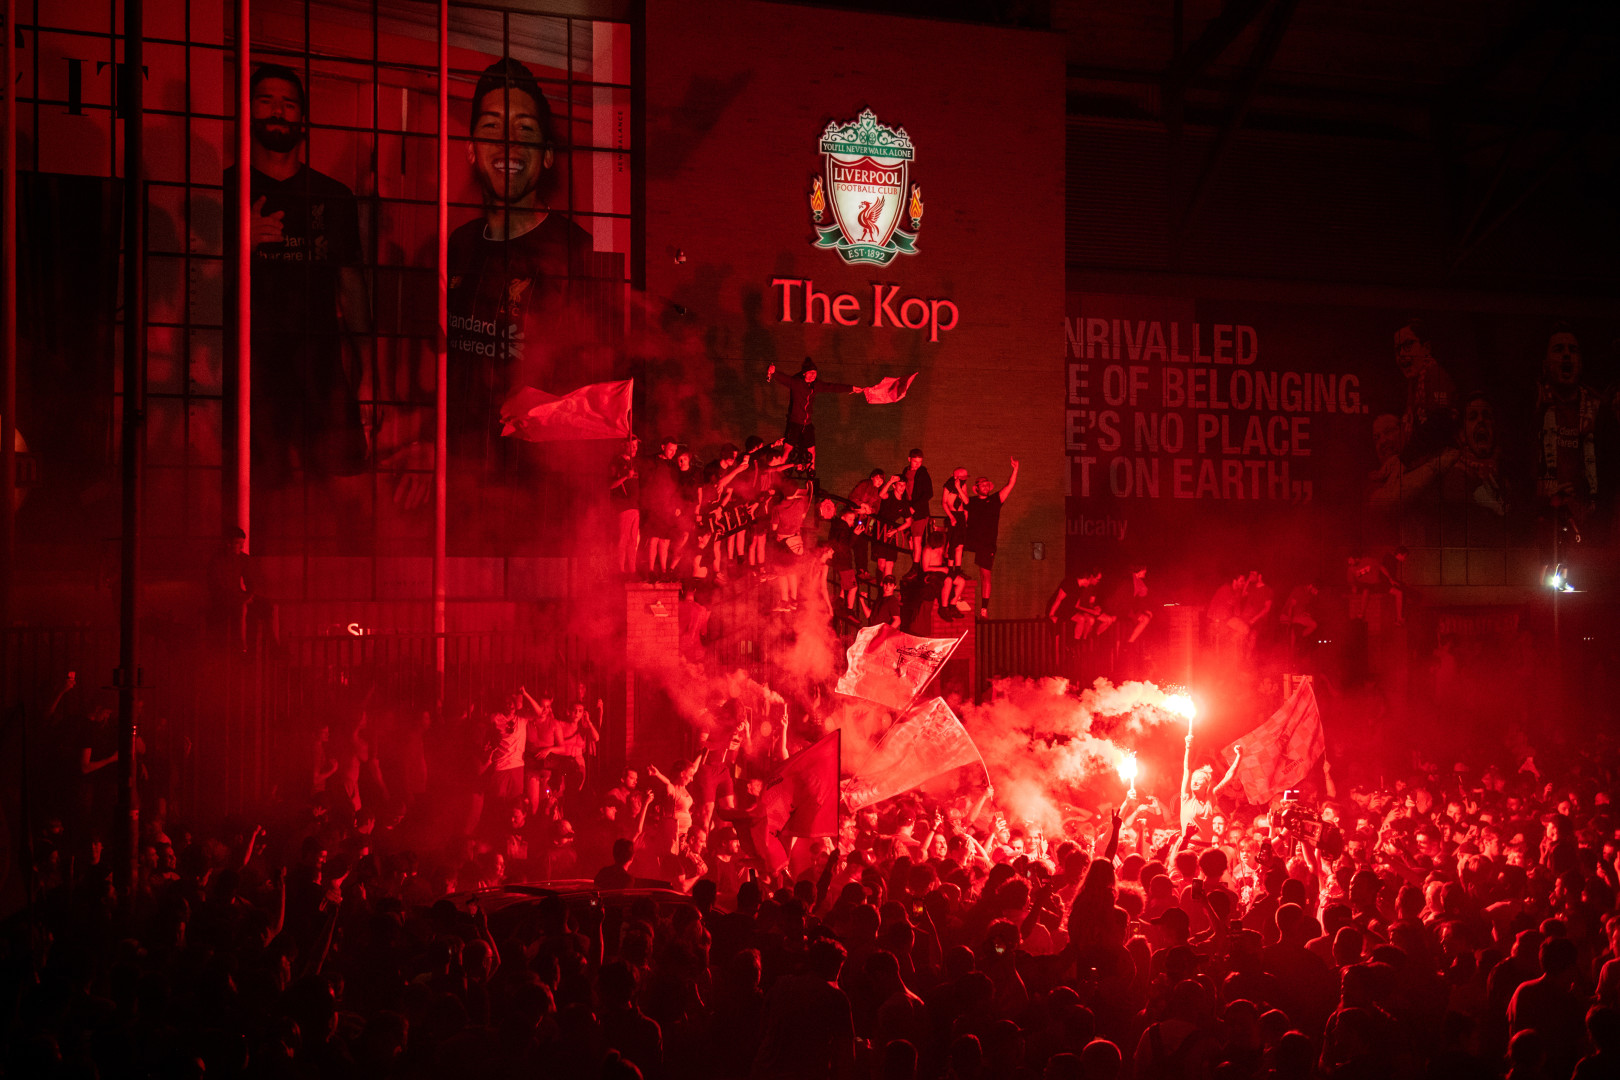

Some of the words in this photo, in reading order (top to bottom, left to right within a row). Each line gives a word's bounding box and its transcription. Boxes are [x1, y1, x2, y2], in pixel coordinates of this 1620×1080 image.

[846, 144, 868, 154] NEVER
[868, 146, 888, 156] WALK
[888, 148, 912, 158] ALONE
[834, 167, 901, 185] LIVERPOOL
[836, 183, 877, 194] FOOTBALL
[877, 186, 898, 195] CLUB
[771, 278, 861, 326] The
[872, 284, 959, 342] Kop
[1103, 364, 1149, 406] OF
[1162, 367, 1369, 414] BELONGING.
[1134, 412, 1184, 454] NO
[1198, 413, 1311, 456] PLACE
[1109, 456, 1159, 498] ON
